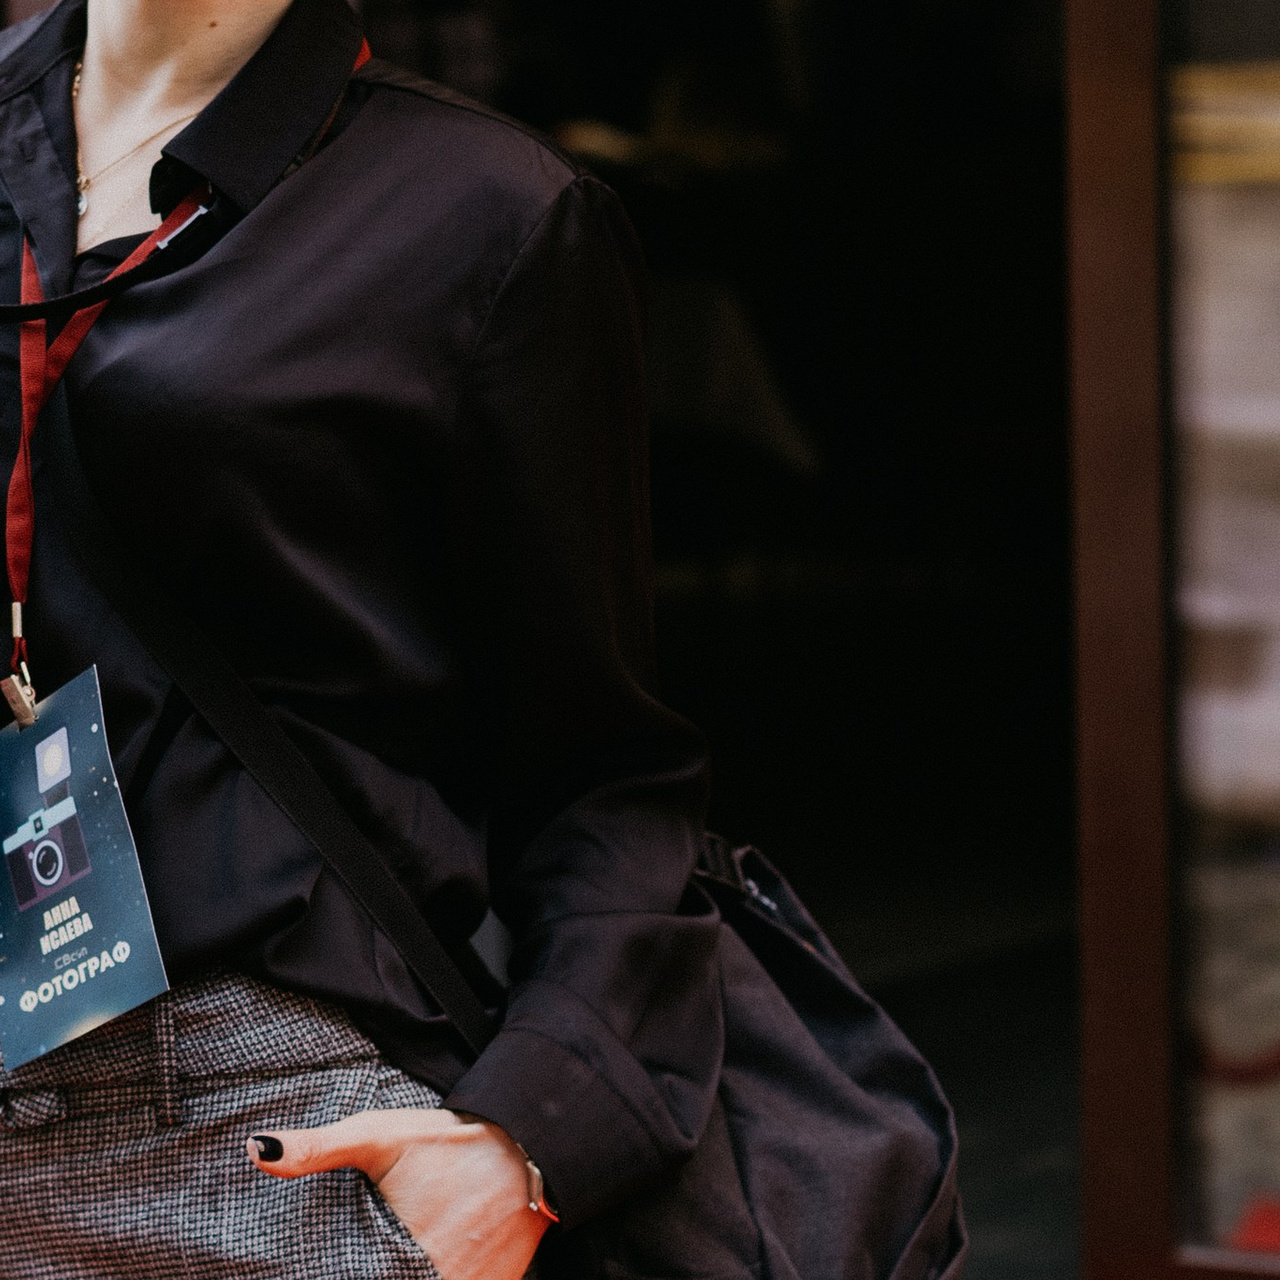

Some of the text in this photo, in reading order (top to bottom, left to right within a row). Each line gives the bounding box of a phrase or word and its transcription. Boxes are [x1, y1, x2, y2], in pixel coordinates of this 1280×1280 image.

[40, 912, 93, 955] ИСАЕВА
[43, 896, 80, 931] АННА
[19, 940, 131, 1012] ФОТОГРАФ
